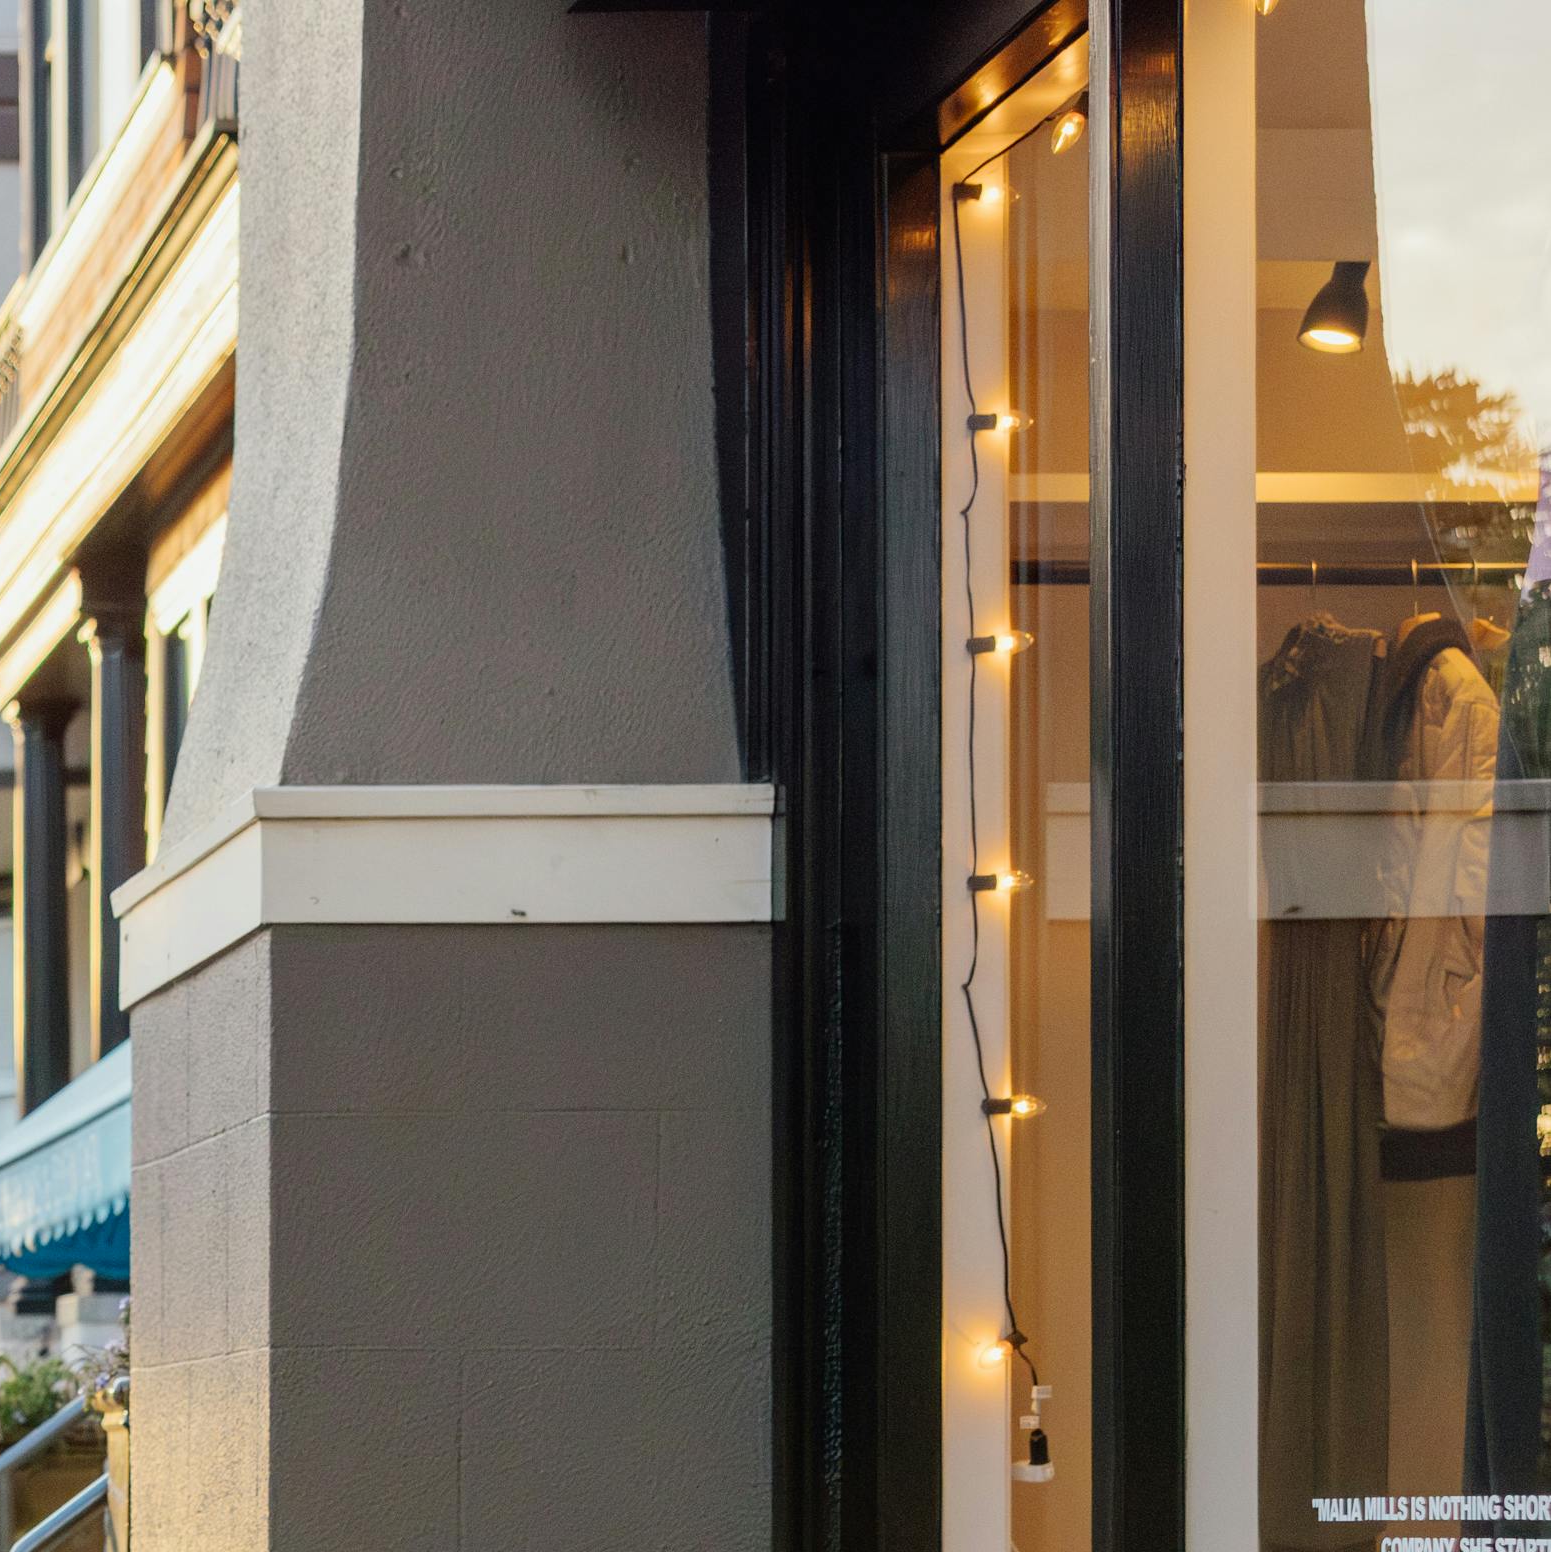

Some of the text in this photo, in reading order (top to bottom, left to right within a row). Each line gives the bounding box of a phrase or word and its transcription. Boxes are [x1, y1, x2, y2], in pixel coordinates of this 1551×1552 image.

[1364, 1496, 1408, 1521] MILLS
[1410, 1496, 1426, 1521] IS
[1428, 1495, 1501, 1521] NOTHING
